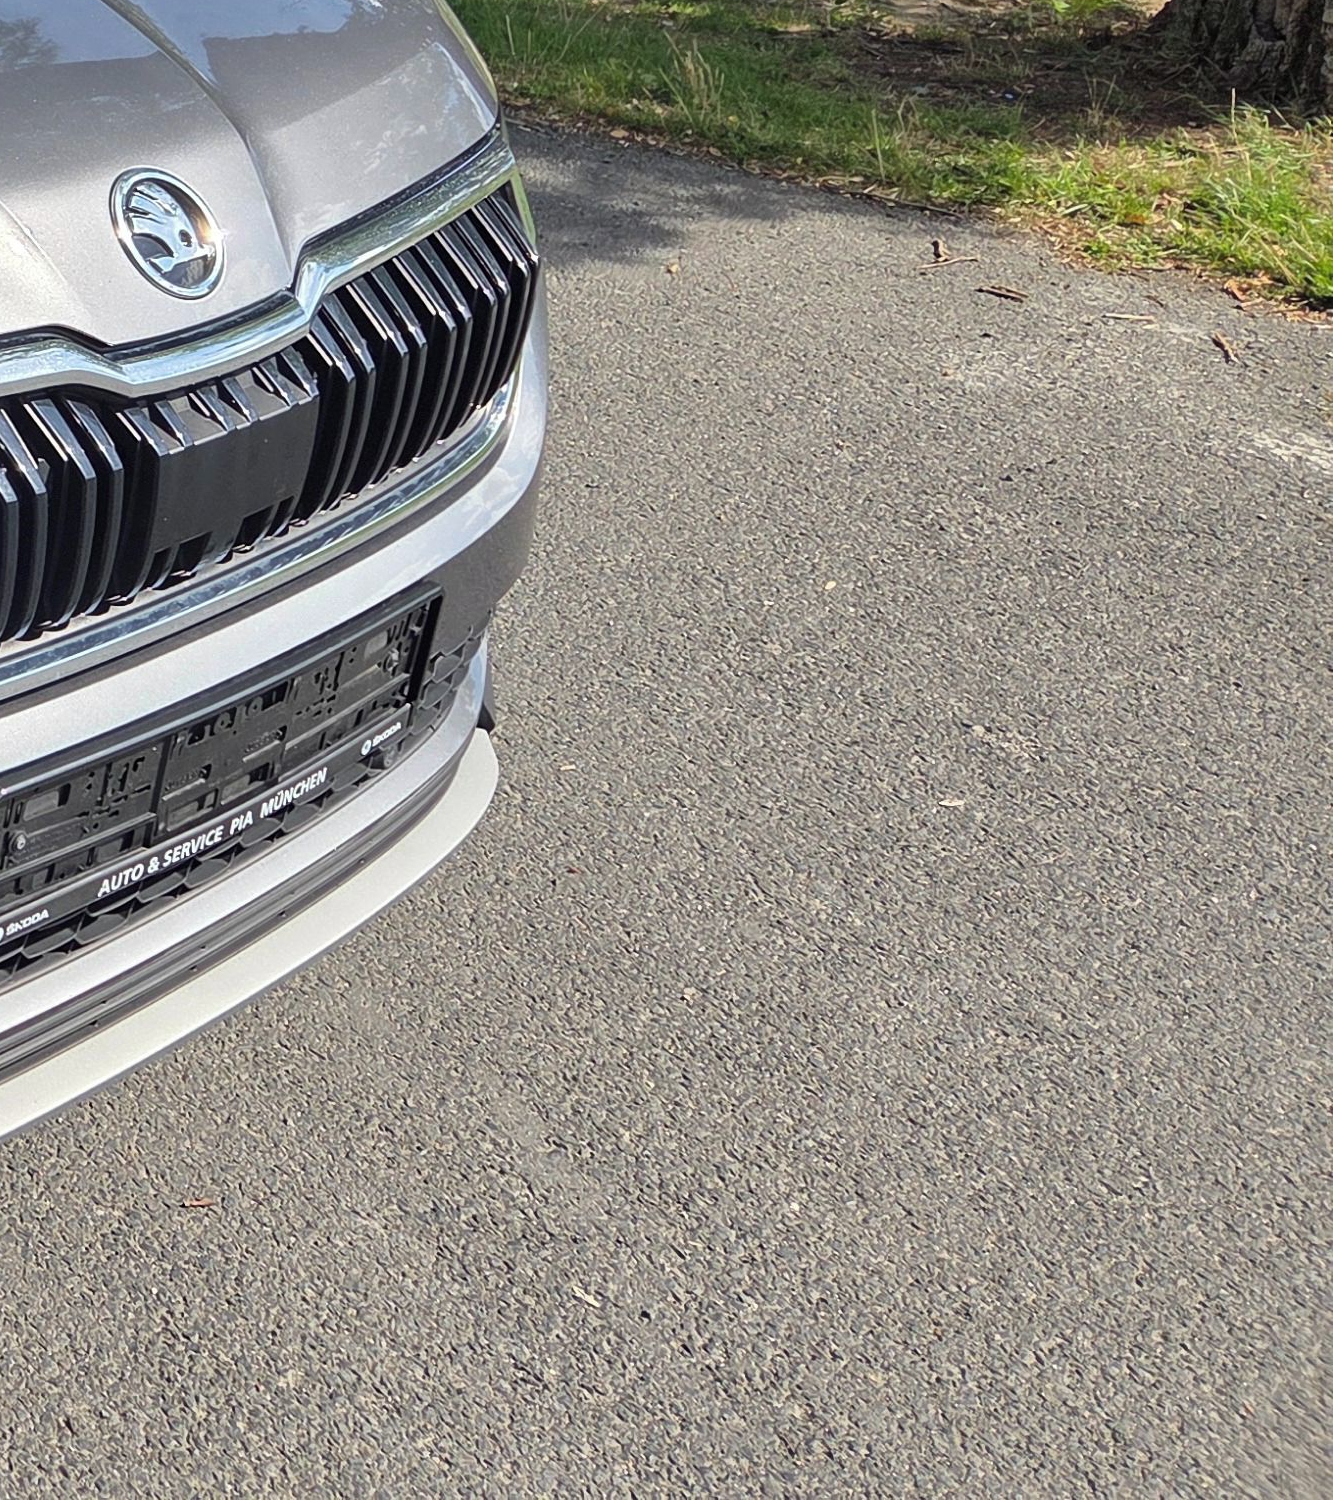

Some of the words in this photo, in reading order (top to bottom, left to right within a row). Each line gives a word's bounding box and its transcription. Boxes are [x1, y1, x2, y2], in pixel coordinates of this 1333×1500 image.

[97, 863, 144, 897] AUTO
[148, 856, 160, 873] &
[162, 825, 224, 867] SERVICE
[230, 810, 253, 835] PIA
[260, 767, 327, 818] MÜNCHEN
